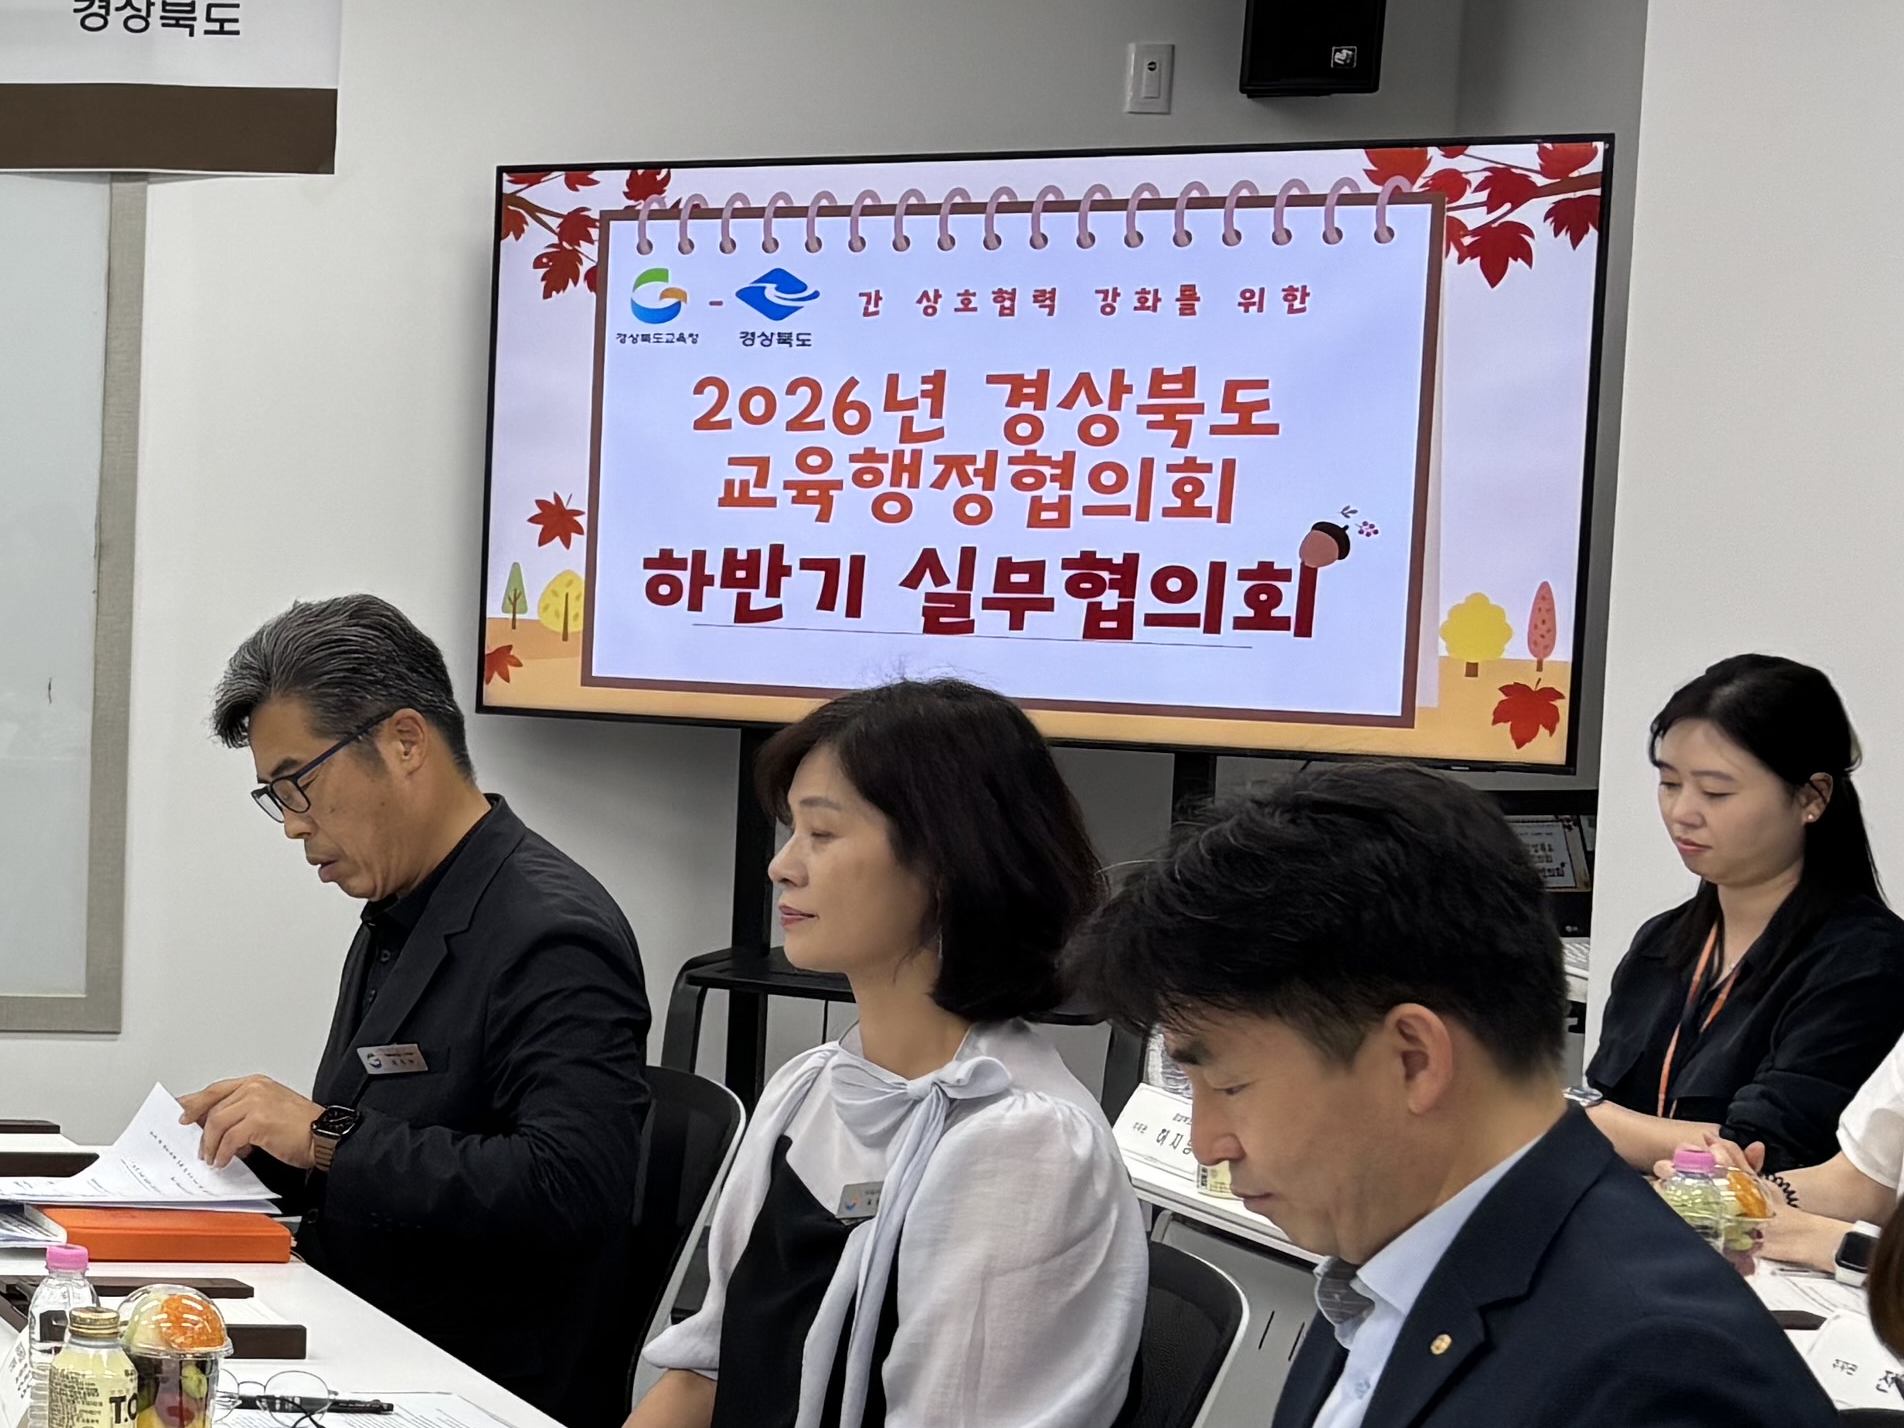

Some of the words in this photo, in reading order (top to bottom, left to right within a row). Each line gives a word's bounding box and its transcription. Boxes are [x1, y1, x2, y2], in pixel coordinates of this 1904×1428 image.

[858, 289, 883, 317] 간
[915, 287, 1057, 318] 상호협력
[1094, 283, 1201, 318] 강화를
[1237, 284, 1311, 316] 위한
[616, 332, 700, 345] 경상북도교육청
[739, 330, 813, 348] 경상북도
[692, 369, 948, 444] 2026년
[985, 365, 1280, 450] 경상북도
[717, 446, 1237, 530] 교육행정협의회
[643, 543, 871, 627] 하반기
[898, 544, 1318, 641] 실무협의회
